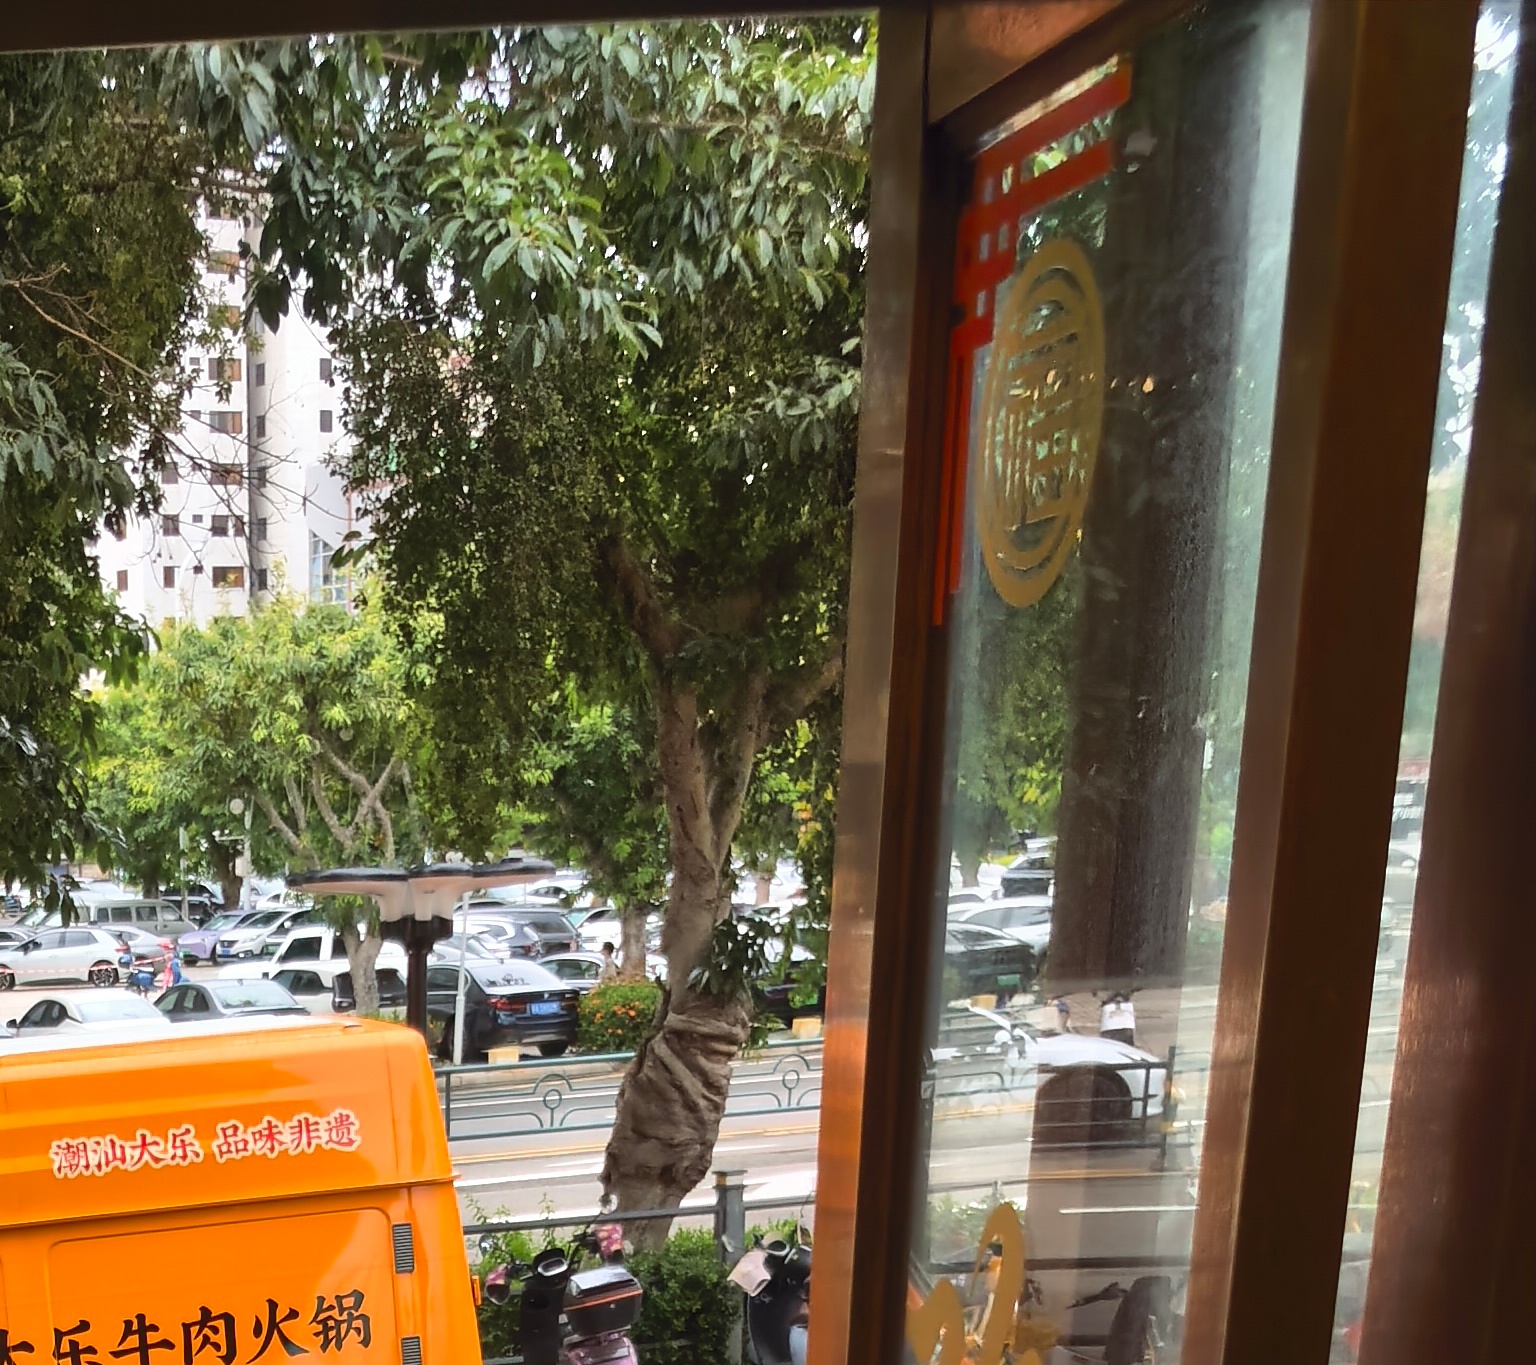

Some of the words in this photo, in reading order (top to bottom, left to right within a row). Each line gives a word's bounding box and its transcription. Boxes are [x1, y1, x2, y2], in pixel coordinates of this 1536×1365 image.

[52, 1126, 201, 1176] 潮汕大乐
[215, 1111, 358, 1161] 品味非遗
